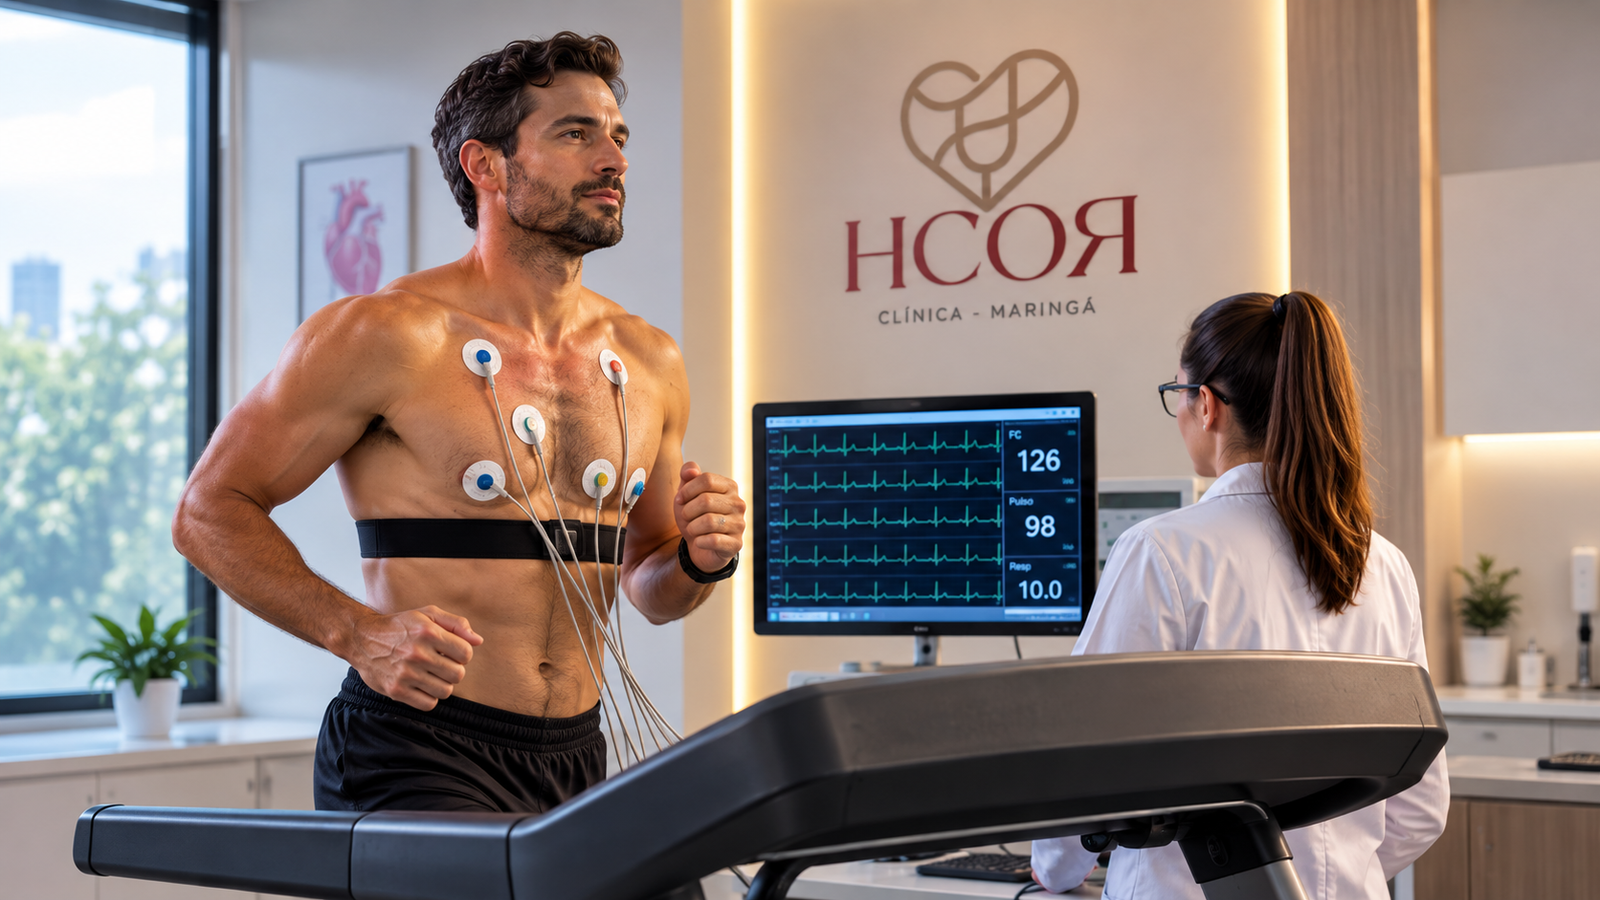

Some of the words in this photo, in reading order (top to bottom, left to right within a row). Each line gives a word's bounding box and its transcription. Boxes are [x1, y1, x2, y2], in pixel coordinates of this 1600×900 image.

[878, 306, 962, 325] CLÍNICA
[991, 297, 1096, 319] MARINGÁ
[1008, 429, 1022, 440] FC
[1017, 448, 1061, 472] 126
[1008, 496, 1034, 507] Pulso
[1024, 514, 1056, 538] 98
[1008, 561, 1032, 573] Resp
[1018, 579, 1063, 600] 10.0
